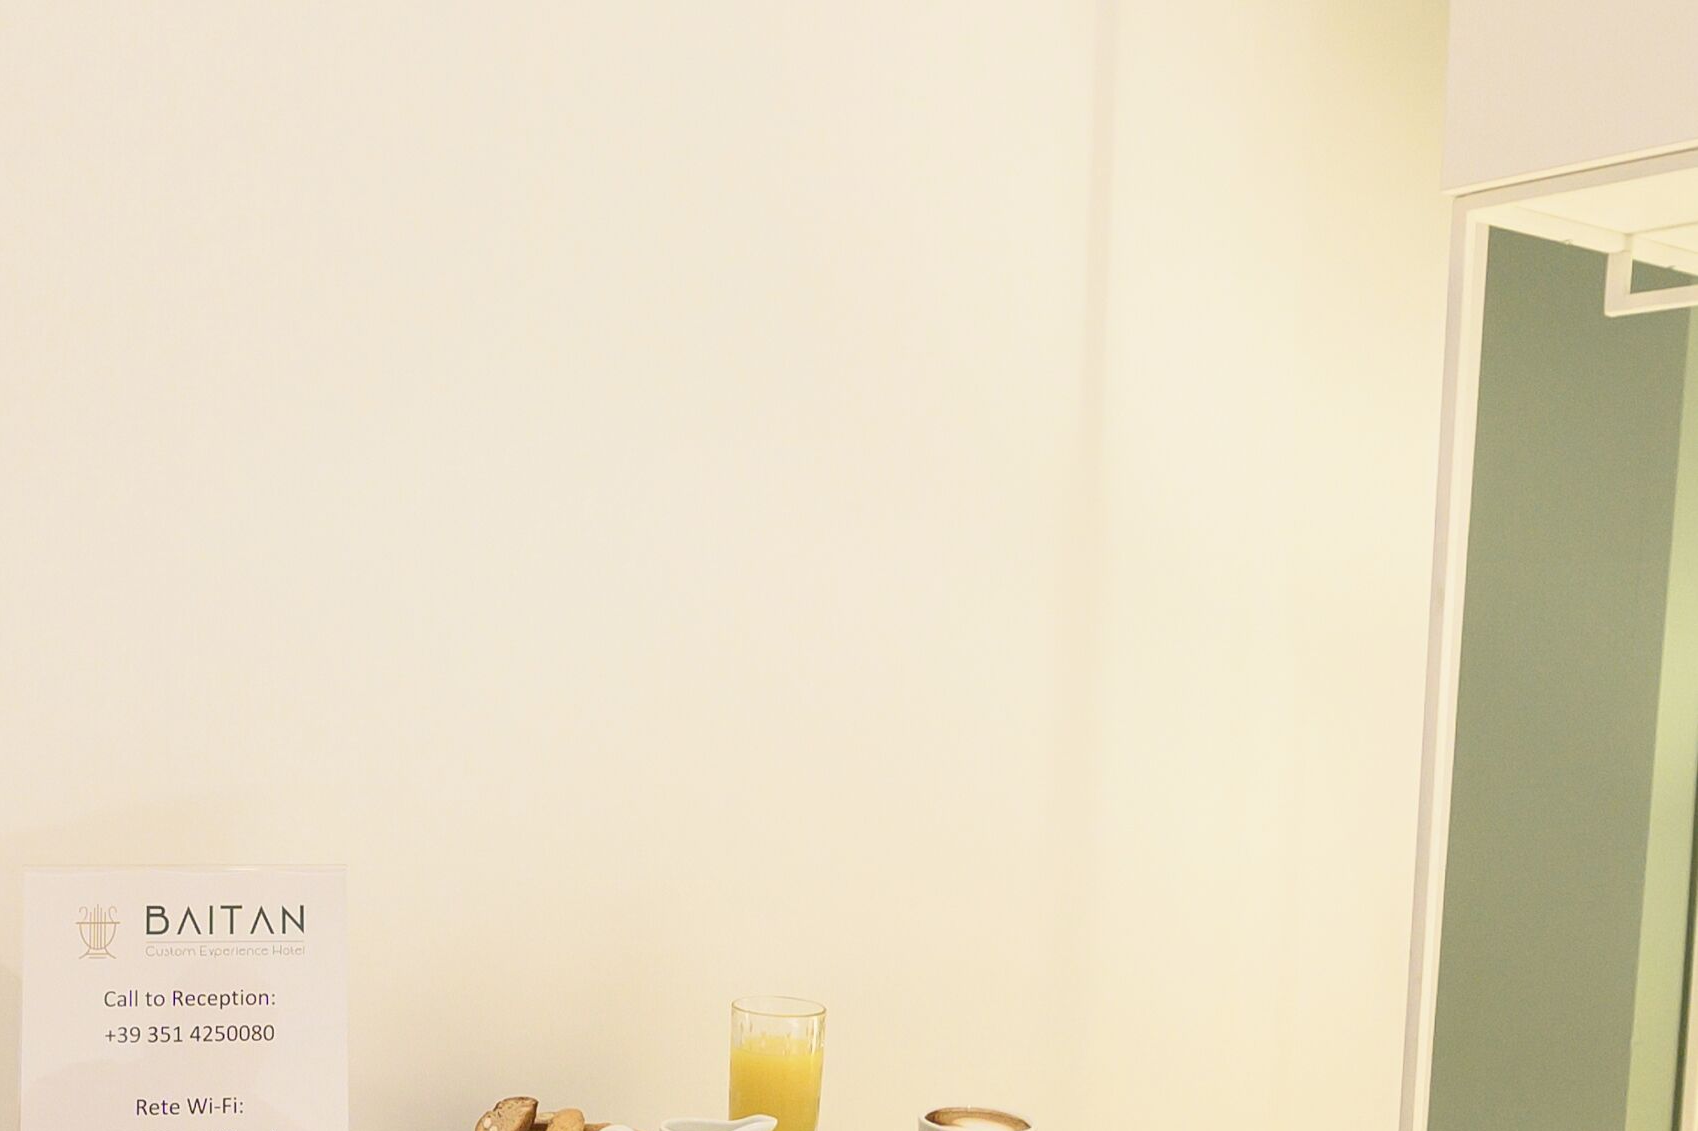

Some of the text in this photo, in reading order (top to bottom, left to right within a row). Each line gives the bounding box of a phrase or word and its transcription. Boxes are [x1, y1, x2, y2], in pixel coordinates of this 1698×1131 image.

[145, 904, 304, 936] BAITAN
[145, 944, 306, 959] Custom Experience Hotel
[103, 989, 276, 1010] Call to Reception:
[104, 1024, 275, 1044] +39 351 4250080
[135, 1096, 245, 1116] Rete Wi-Fi:
